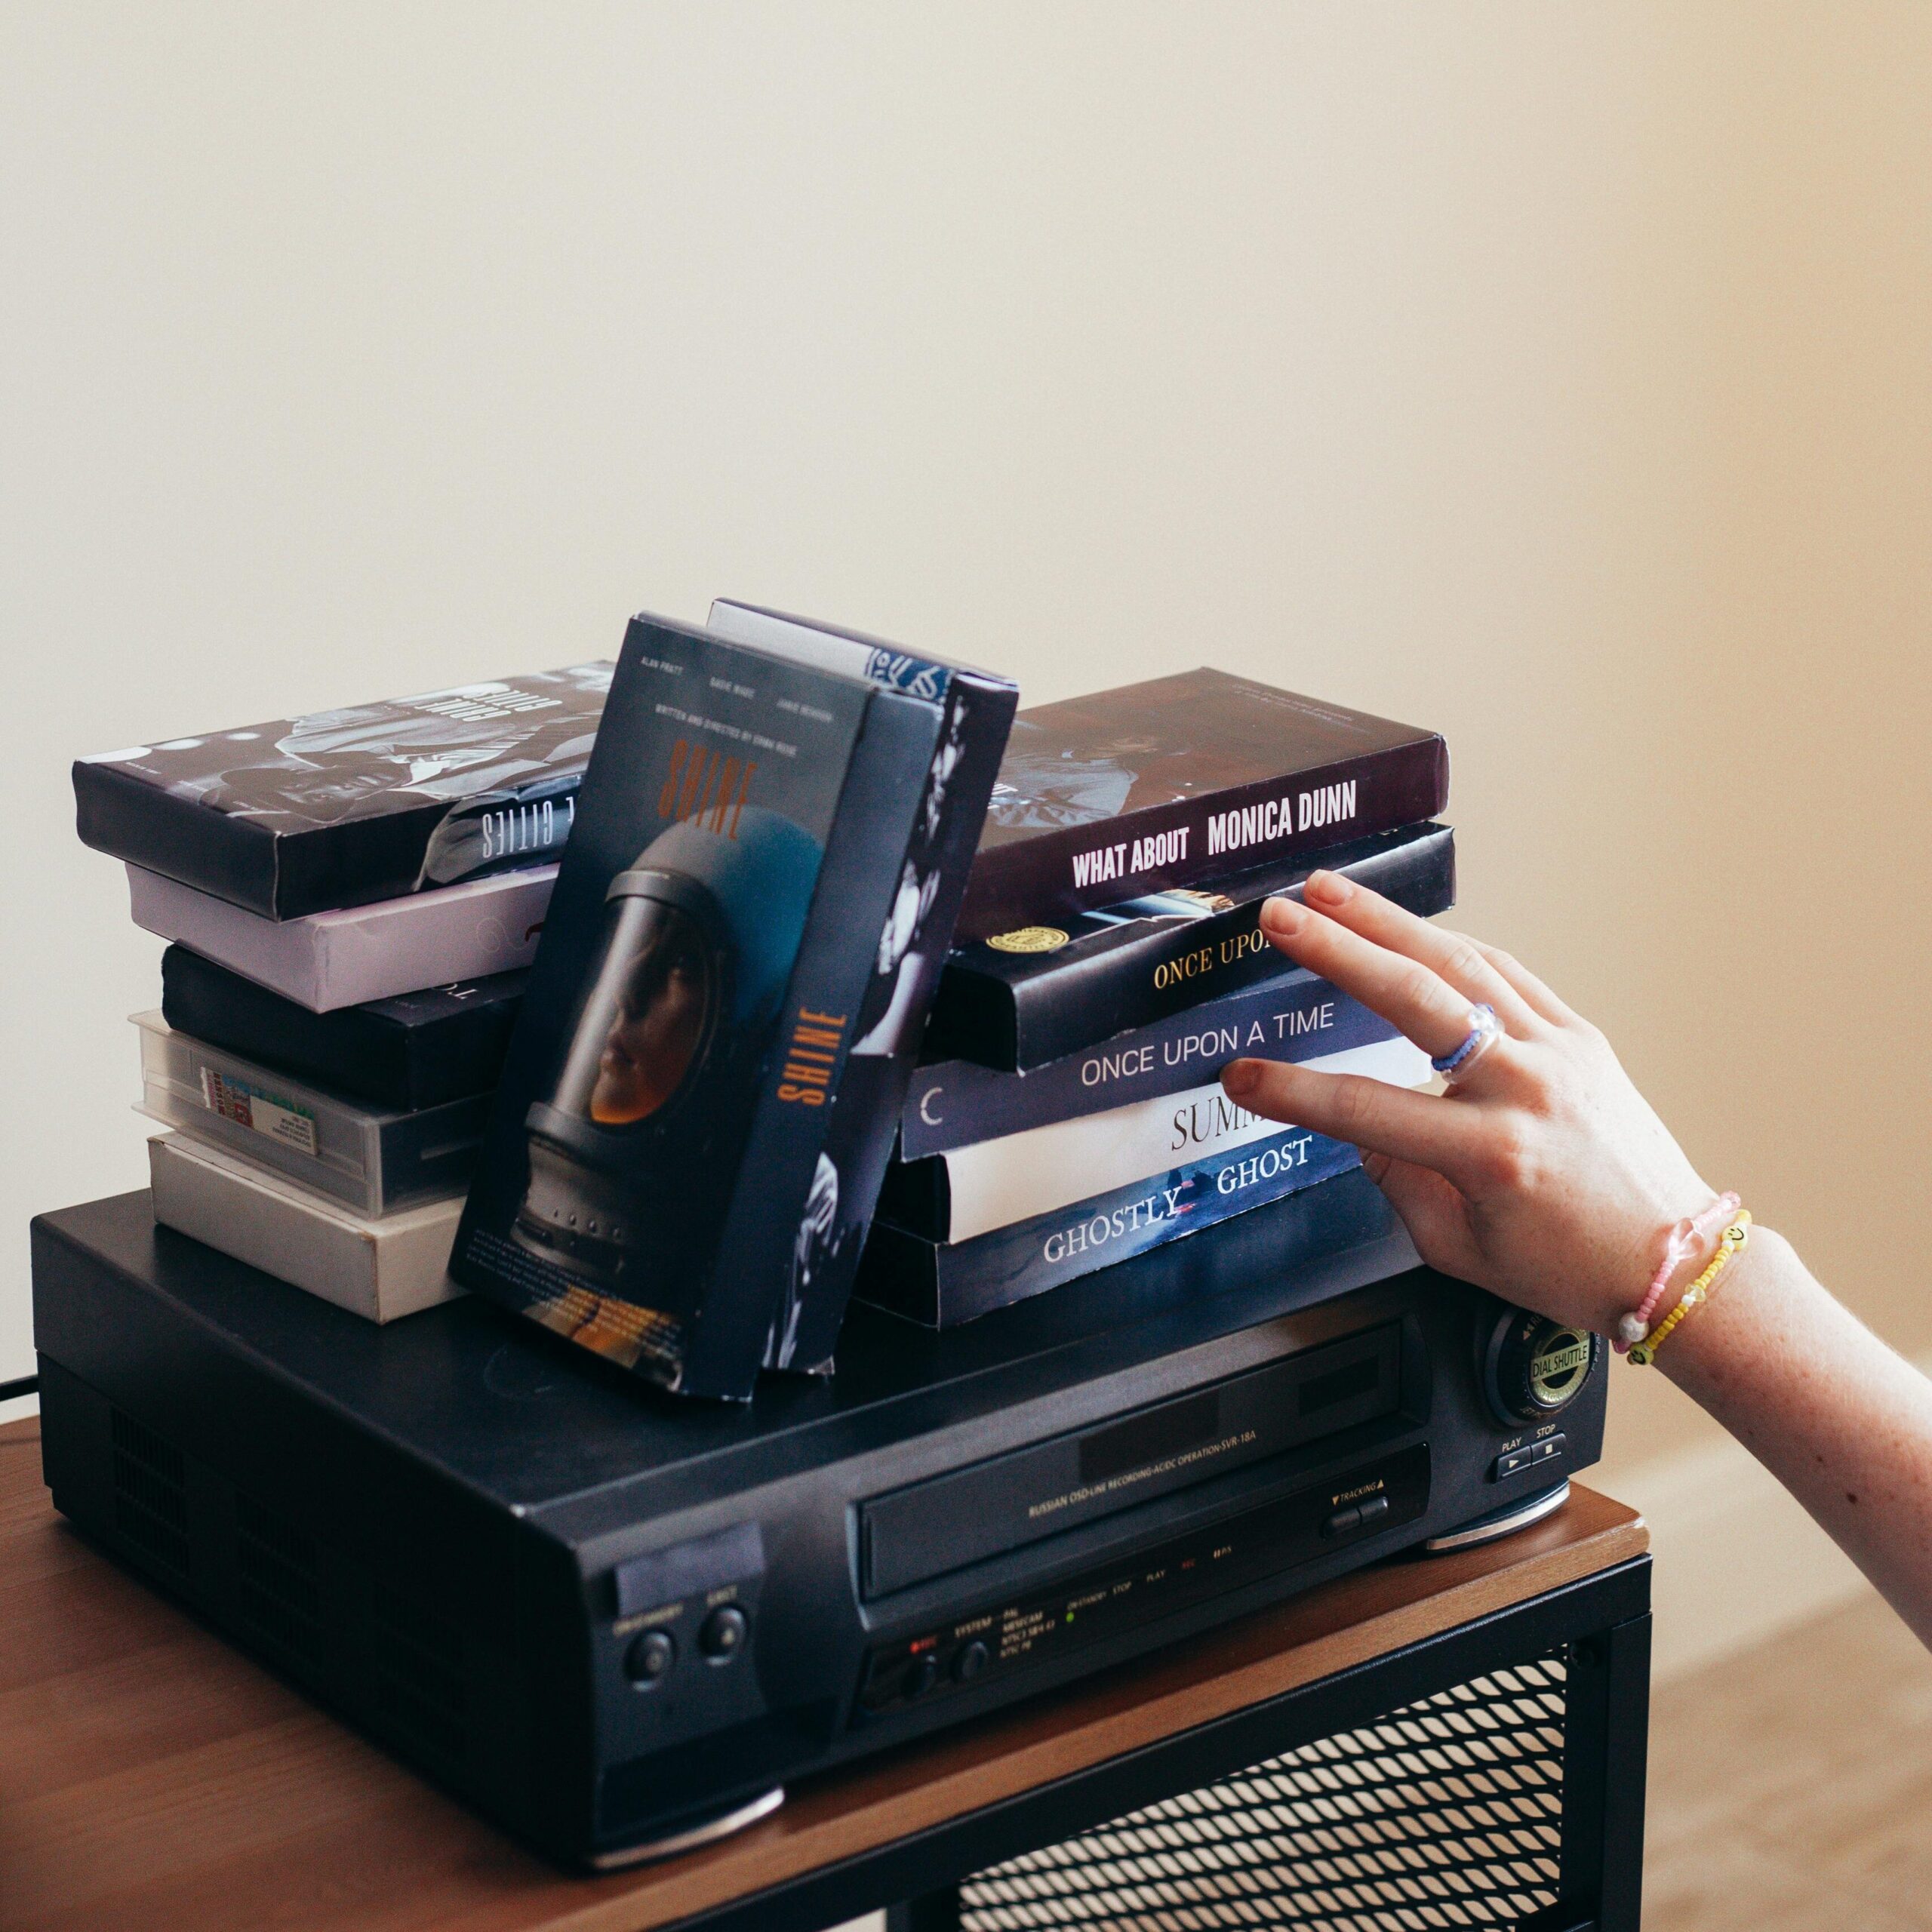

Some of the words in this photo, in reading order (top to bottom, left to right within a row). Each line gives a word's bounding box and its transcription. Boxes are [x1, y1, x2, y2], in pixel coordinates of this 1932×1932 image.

[657, 739, 758, 841] SHINE
[482, 800, 553, 858] CITIES
[1072, 843, 1127, 888] WHAT
[1131, 826, 1190, 874] ABOUT
[1208, 797, 1292, 856] MONICA
[1298, 780, 1356, 832] DUNN
[1154, 947, 1213, 989] ONCE
[1220, 929, 1271, 964] UPO
[777, 1007, 848, 1106] SHINE
[1081, 1045, 1155, 1086] ONCE
[1164, 1026, 1238, 1066] UPON
[1246, 1020, 1265, 1047] A
[1272, 1002, 1335, 1039] TIME
[1043, 1186, 1183, 1263] GHOSTLY
[1217, 1134, 1313, 1195] GHOST
[1533, 1358, 1552, 1378] DIAL
[1554, 1345, 1588, 1371] SHUTTLE
[1502, 1437, 1521, 1454] PLAY
[1537, 1423, 1556, 1438] STOP
[1029, 1496, 1067, 1518] RUSSIAN
[1340, 1482, 1376, 1501] TRACKING
[1146, 1569, 1166, 1582] PLAY
[955, 1616, 992, 1638] SYSTEM
